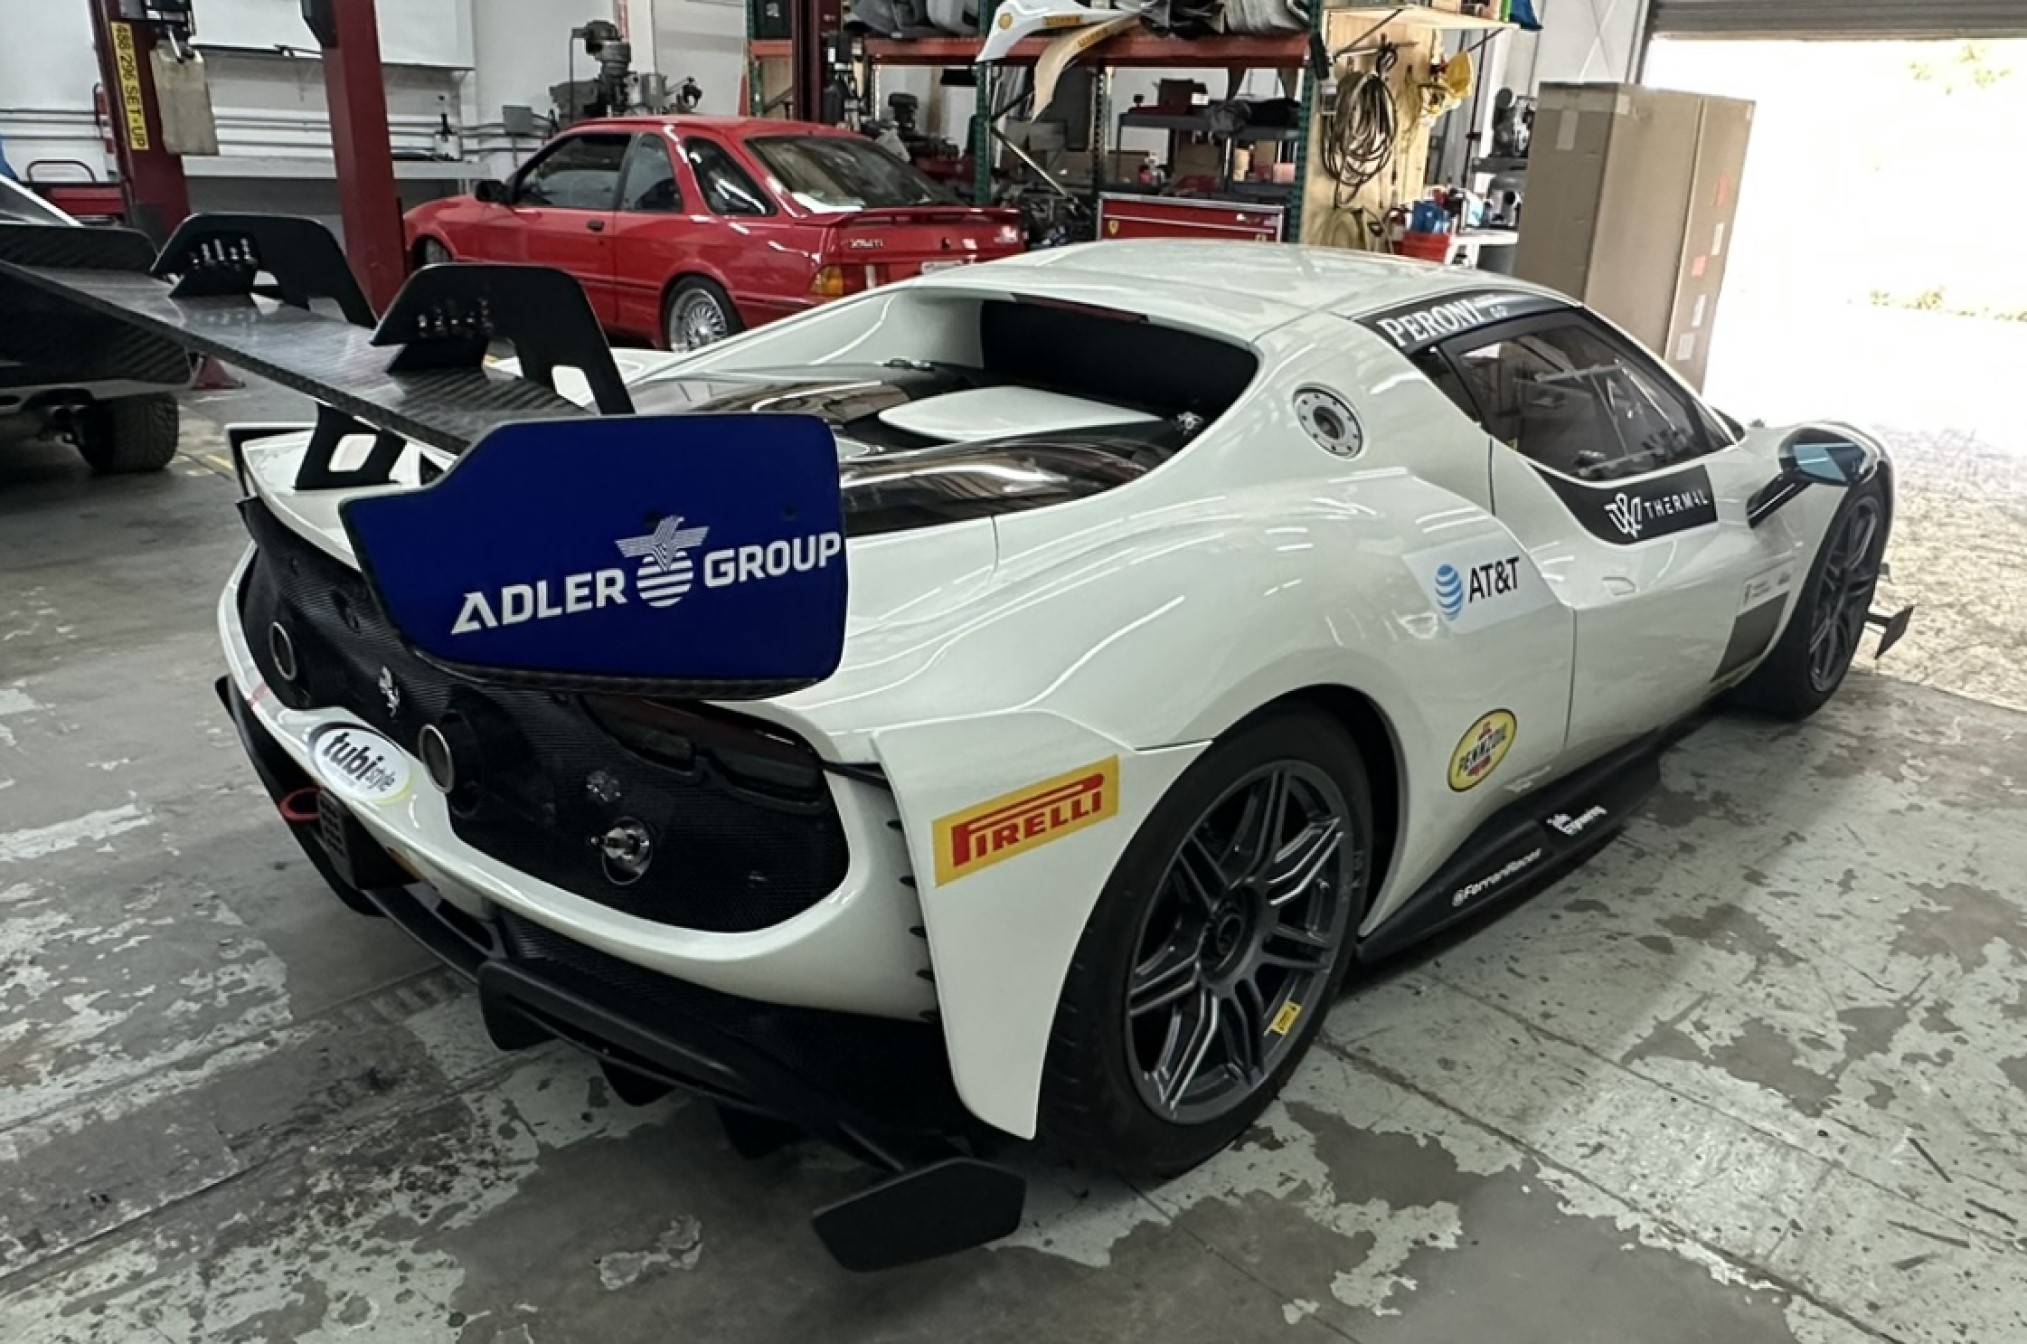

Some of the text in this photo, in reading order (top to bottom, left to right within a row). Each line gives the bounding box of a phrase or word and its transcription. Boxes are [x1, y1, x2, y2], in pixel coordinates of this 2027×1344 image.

[1376, 299, 1486, 347] PERONI
[451, 531, 842, 635] ADLER GROUP
[1468, 555, 1520, 604] AT&T
[322, 731, 385, 781] tubi
[951, 773, 1105, 868] PIRELLI
